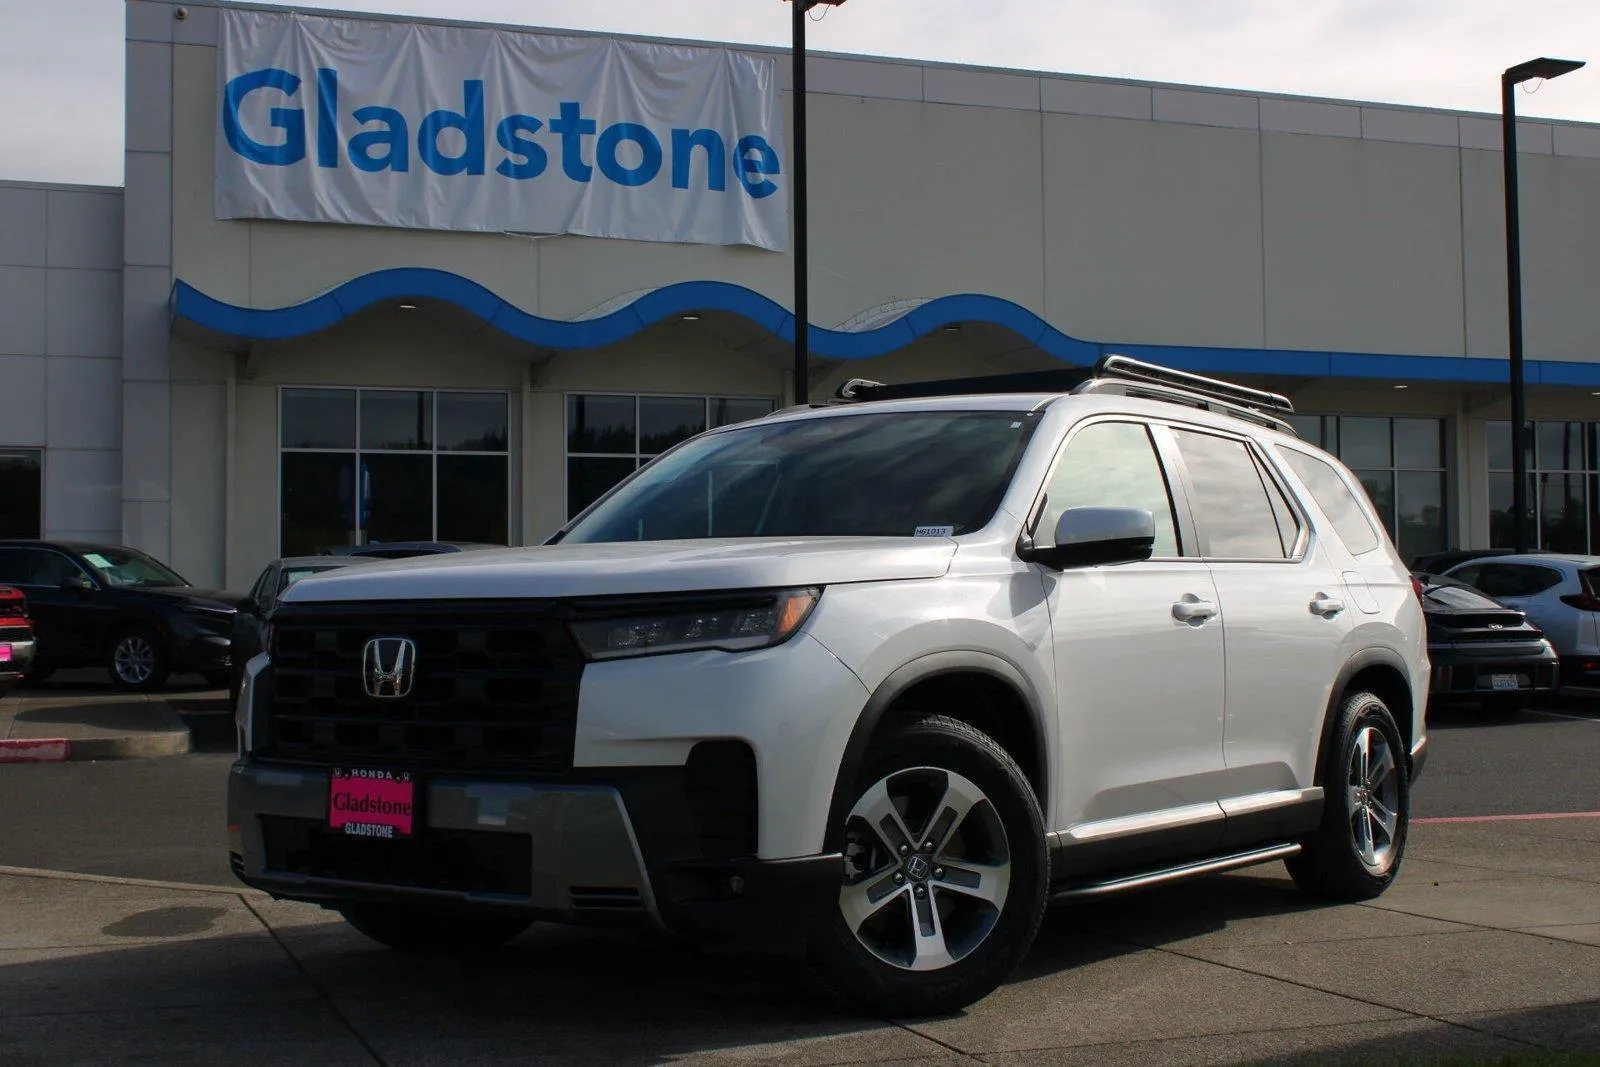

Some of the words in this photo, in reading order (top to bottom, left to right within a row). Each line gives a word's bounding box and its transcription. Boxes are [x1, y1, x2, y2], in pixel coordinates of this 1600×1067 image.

[222, 67, 781, 199] Gladstone
[351, 768, 393, 780] HONDA
[332, 791, 412, 817] Gladstone
[344, 822, 393, 838] GLADSTONE
